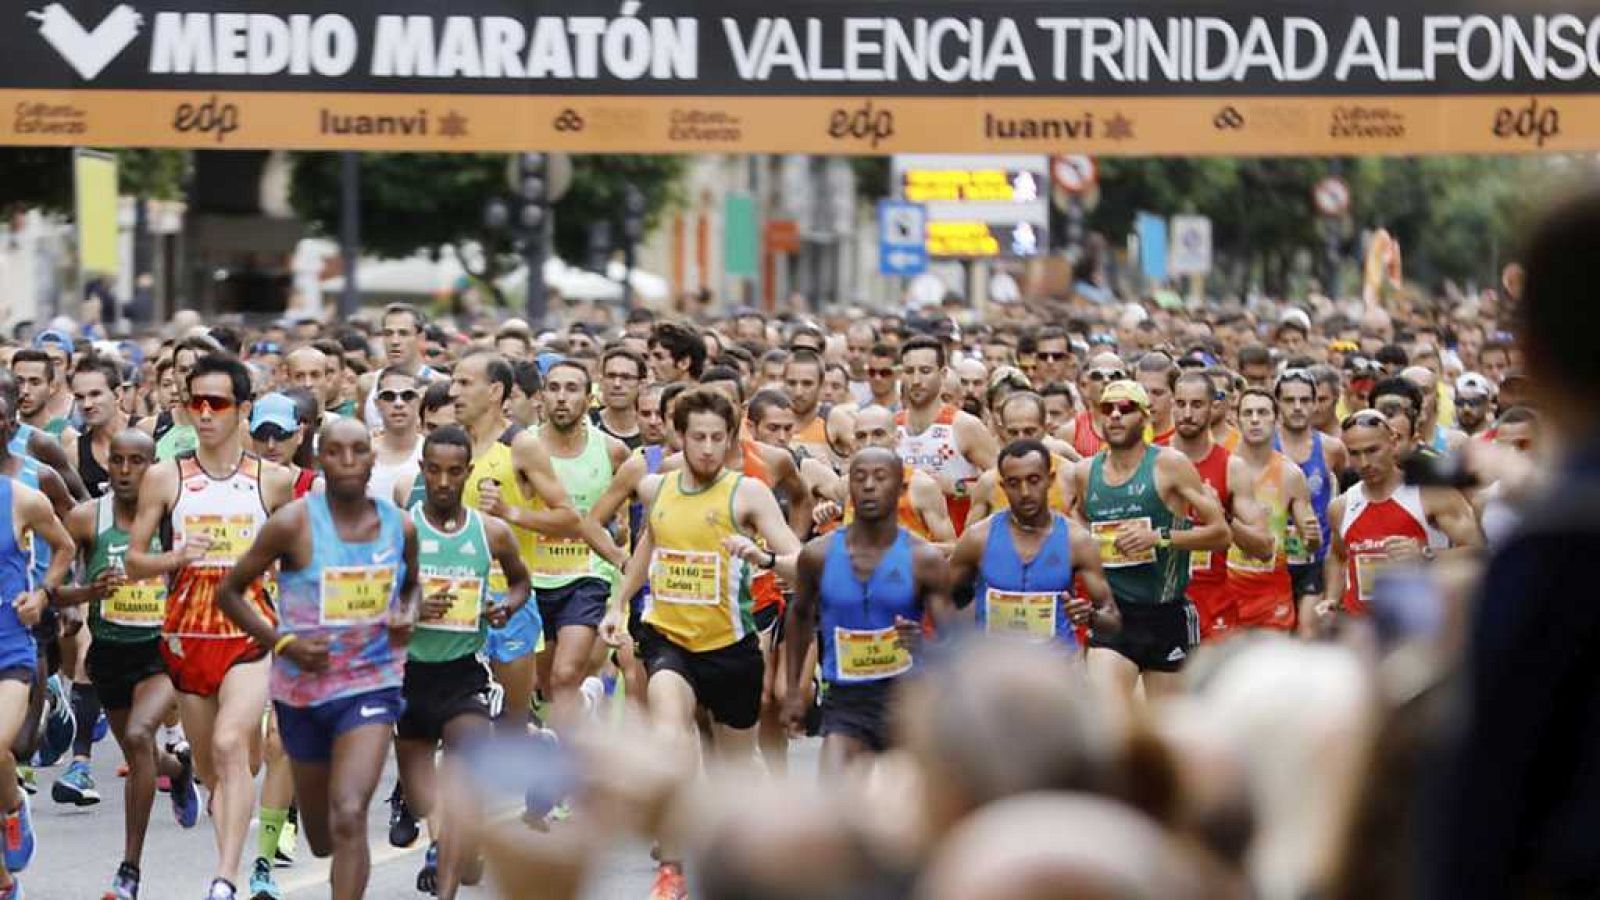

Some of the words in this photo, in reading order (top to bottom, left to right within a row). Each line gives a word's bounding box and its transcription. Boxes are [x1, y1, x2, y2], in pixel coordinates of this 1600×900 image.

[149, 12, 358, 76] MEDIO
[371, 0, 697, 80] MARATÓN
[722, 17, 1034, 82] VALENCIA
[1037, 17, 1327, 82] TRINIDAD
[320, 108, 428, 137] luanvi
[984, 111, 1094, 140] luanvi
